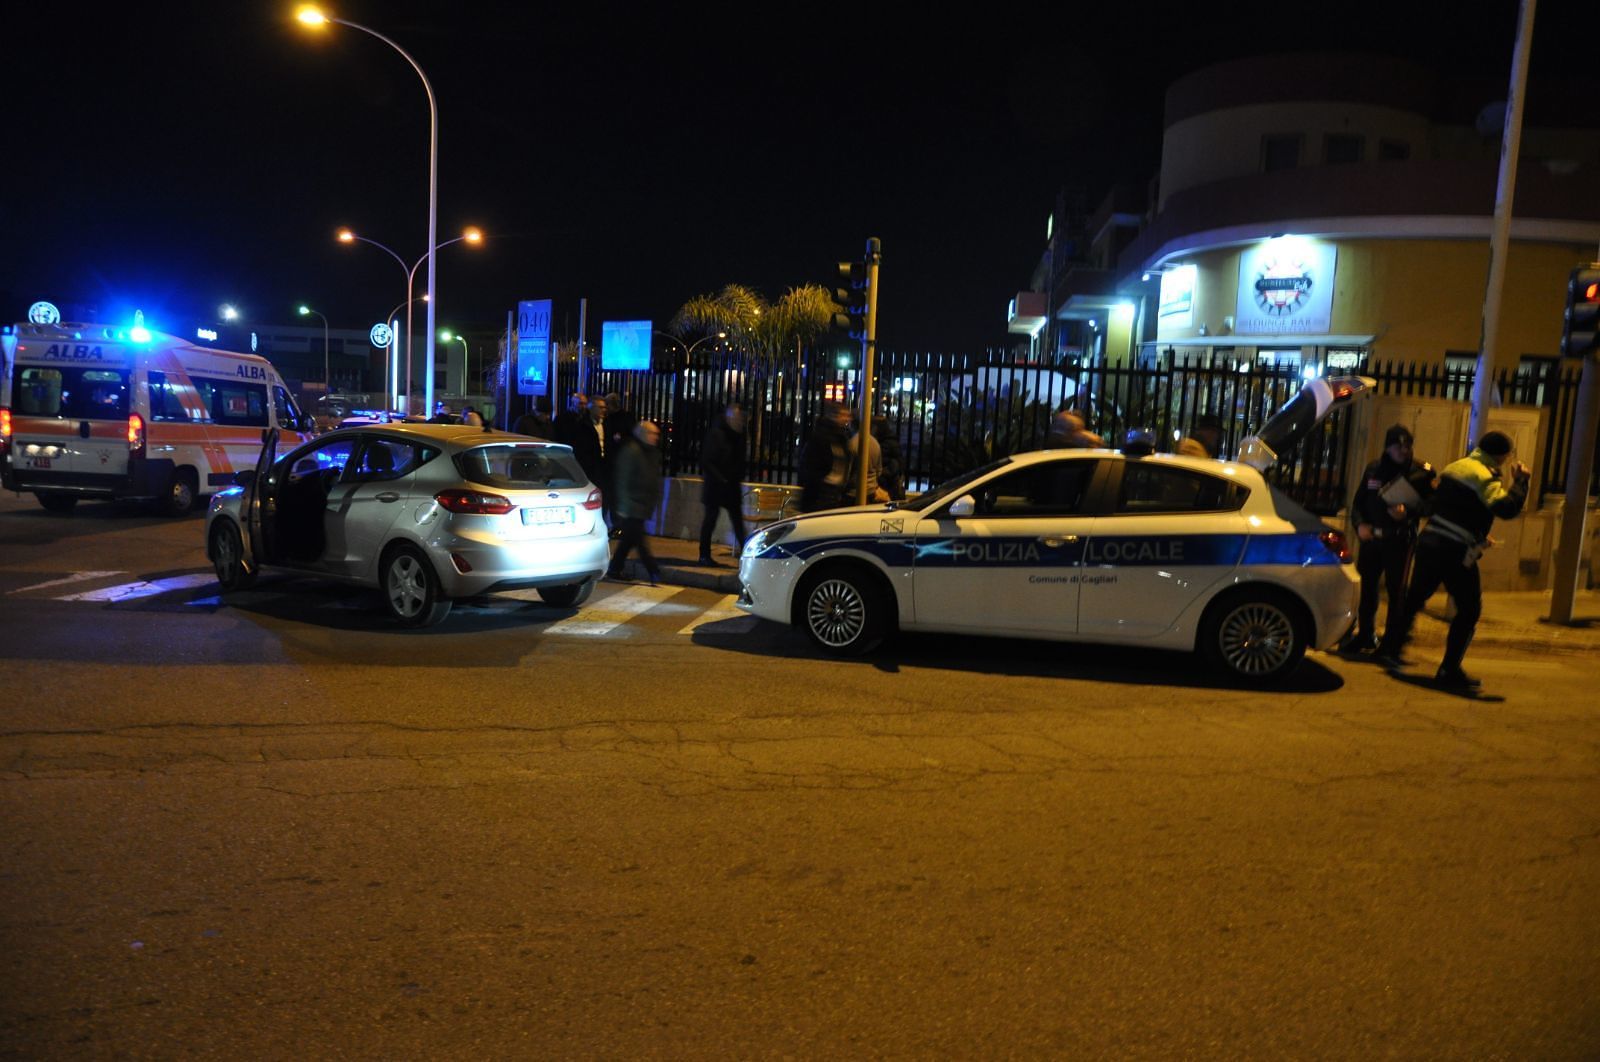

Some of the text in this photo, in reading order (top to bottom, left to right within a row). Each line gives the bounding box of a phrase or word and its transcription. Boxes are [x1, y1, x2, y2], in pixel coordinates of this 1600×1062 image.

[1290, 319, 1312, 328] BAR
[44, 344, 103, 359] ALBA
[236, 364, 267, 380] ALBA
[952, 541, 1185, 562] POLIZIA LOCALE
[1028, 575, 1119, 586] Comune di Cagliari
